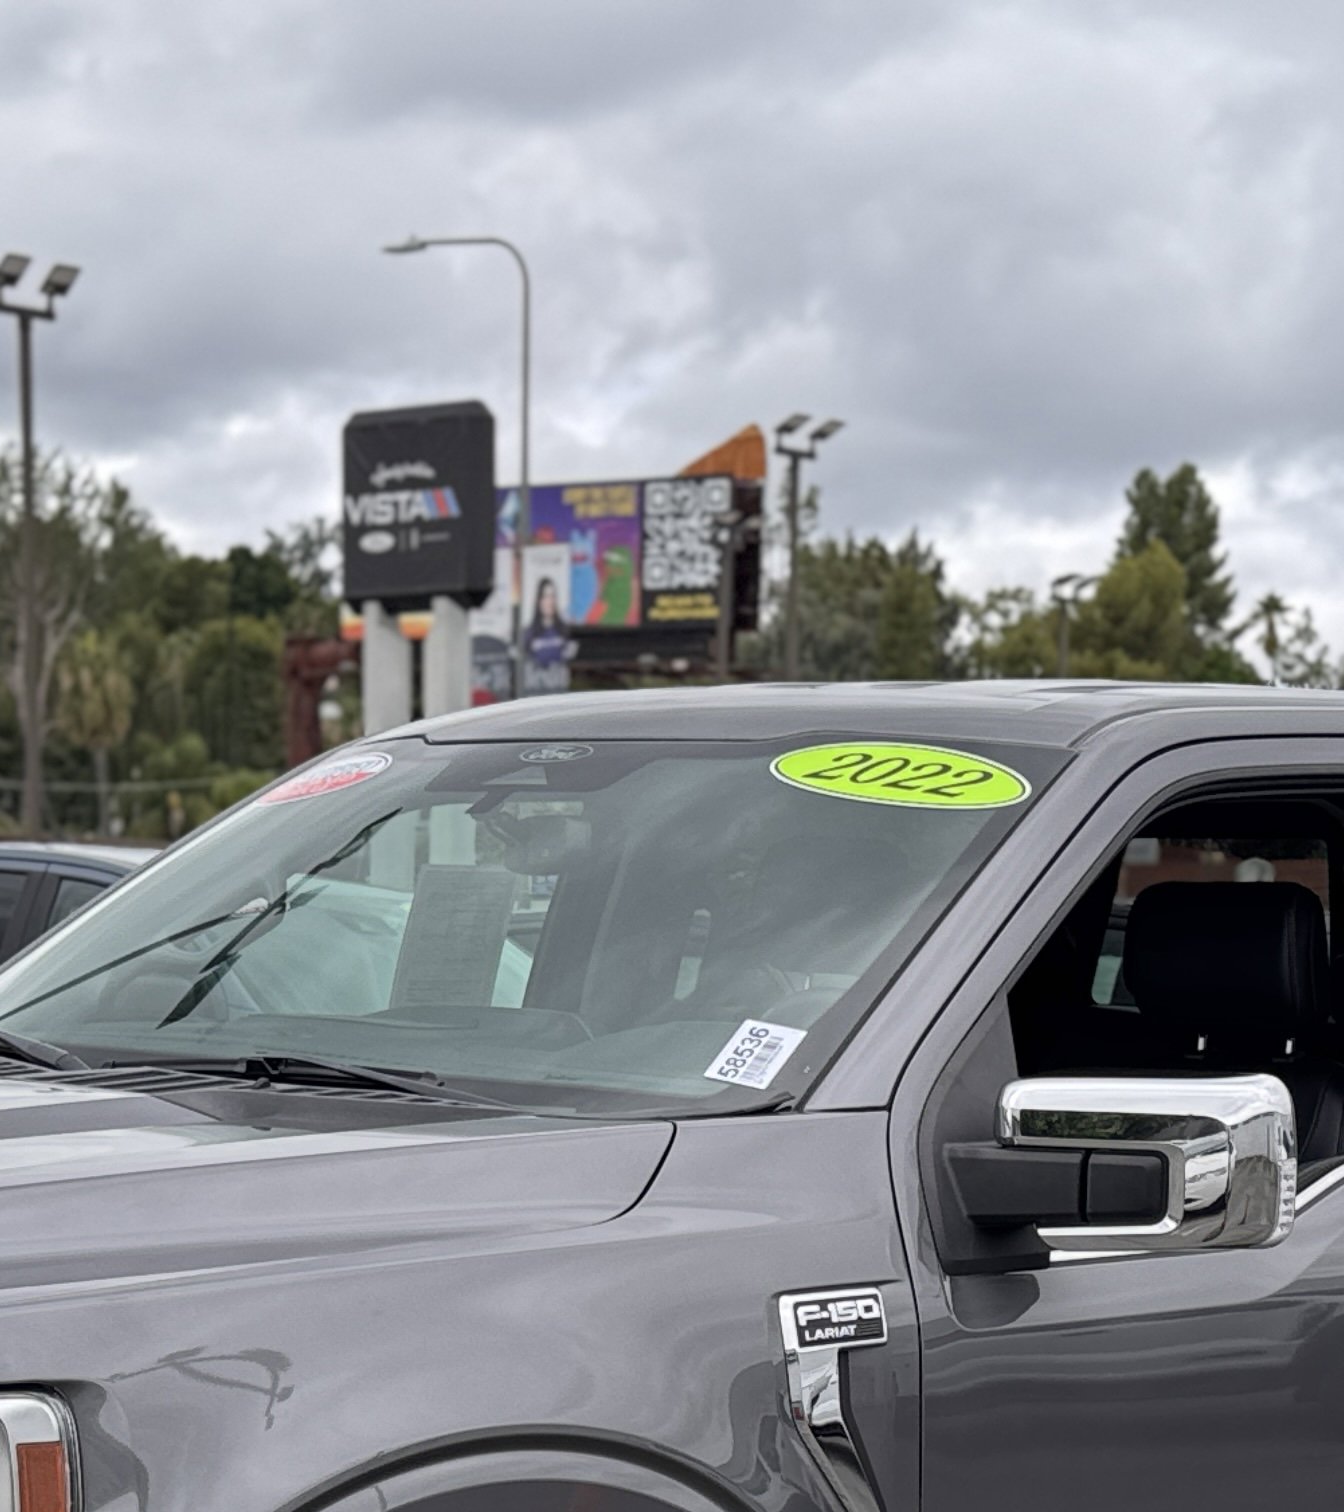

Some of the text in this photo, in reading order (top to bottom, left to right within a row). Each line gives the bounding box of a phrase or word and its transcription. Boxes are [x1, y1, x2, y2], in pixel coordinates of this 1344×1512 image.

[344, 489, 432, 528] VISTA
[801, 752, 994, 798] 2022
[717, 1026, 770, 1079] 58536
[796, 1298, 881, 1327] F-150
[804, 1324, 857, 1342] LARIAT
